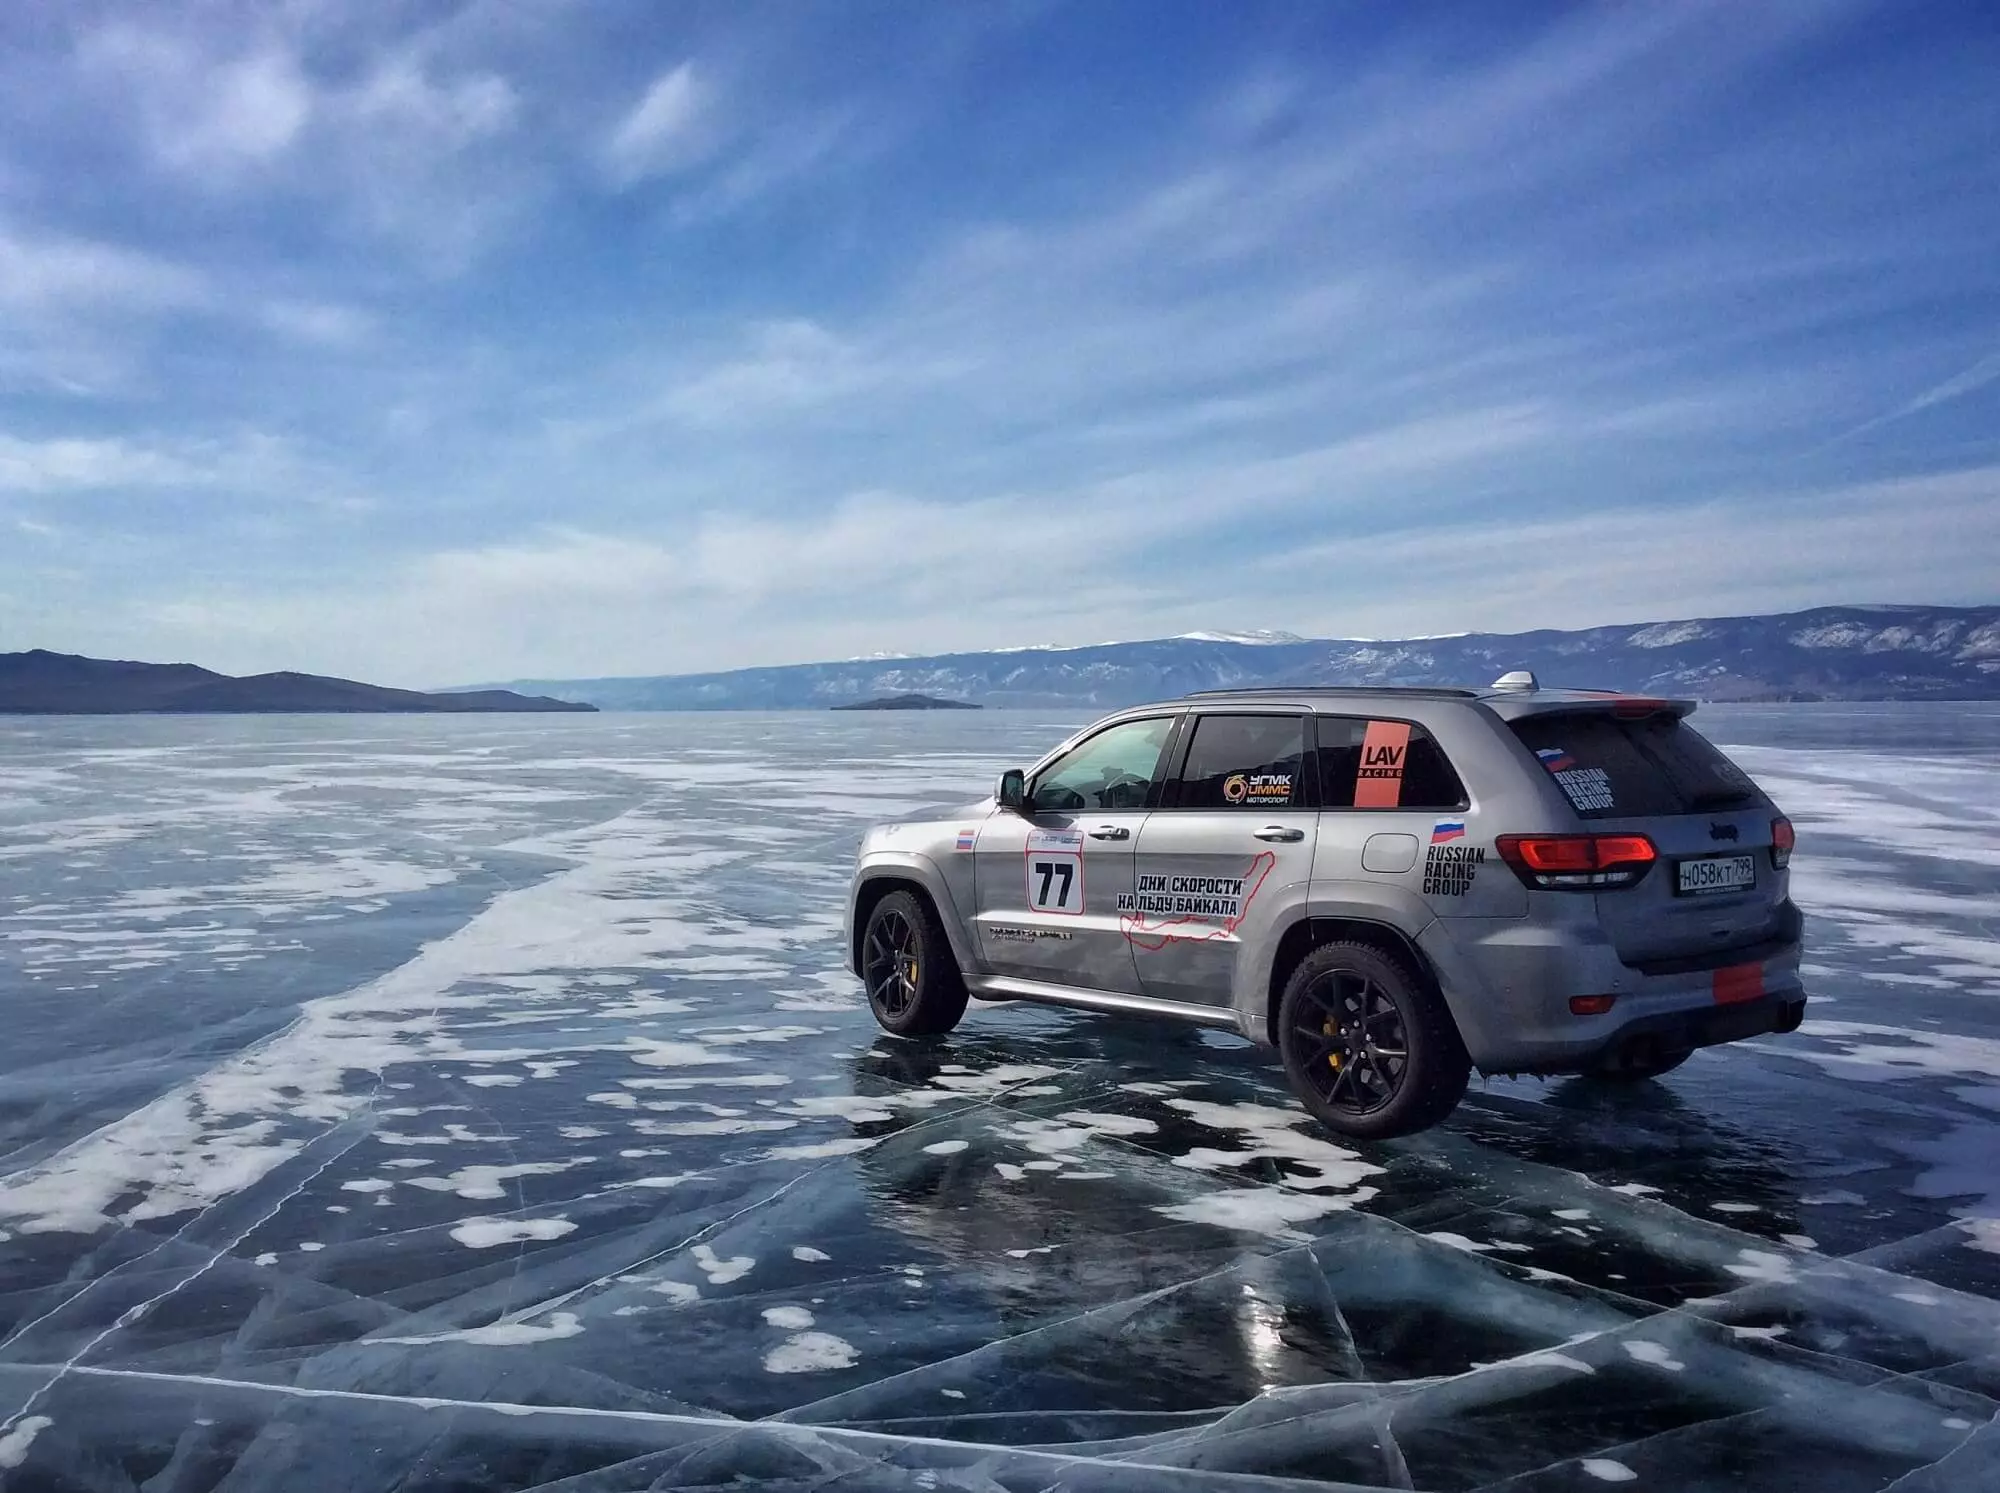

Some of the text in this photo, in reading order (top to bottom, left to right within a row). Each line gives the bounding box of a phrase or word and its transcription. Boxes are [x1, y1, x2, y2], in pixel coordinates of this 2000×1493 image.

[1365, 746, 1403, 766] LAV
[1250, 775, 1292, 785] УГМК
[1358, 769, 1403, 777] RACING
[1553, 767, 1609, 785] RUSSIAN
[1562, 781, 1612, 797] RACING
[1246, 796, 1288, 804] МОТОРСПОРТ
[1572, 794, 1614, 810] GROUP
[1427, 845, 1485, 864] RUSSIAN
[1424, 861, 1476, 880] RACING
[1035, 862, 1073, 907] 77
[1139, 875, 1242, 896] ДНИ СКОРОСТИ
[1423, 878, 1471, 896] GROUP
[1117, 894, 1237, 916] НА ЛЬДУ БАЙКАЛА
